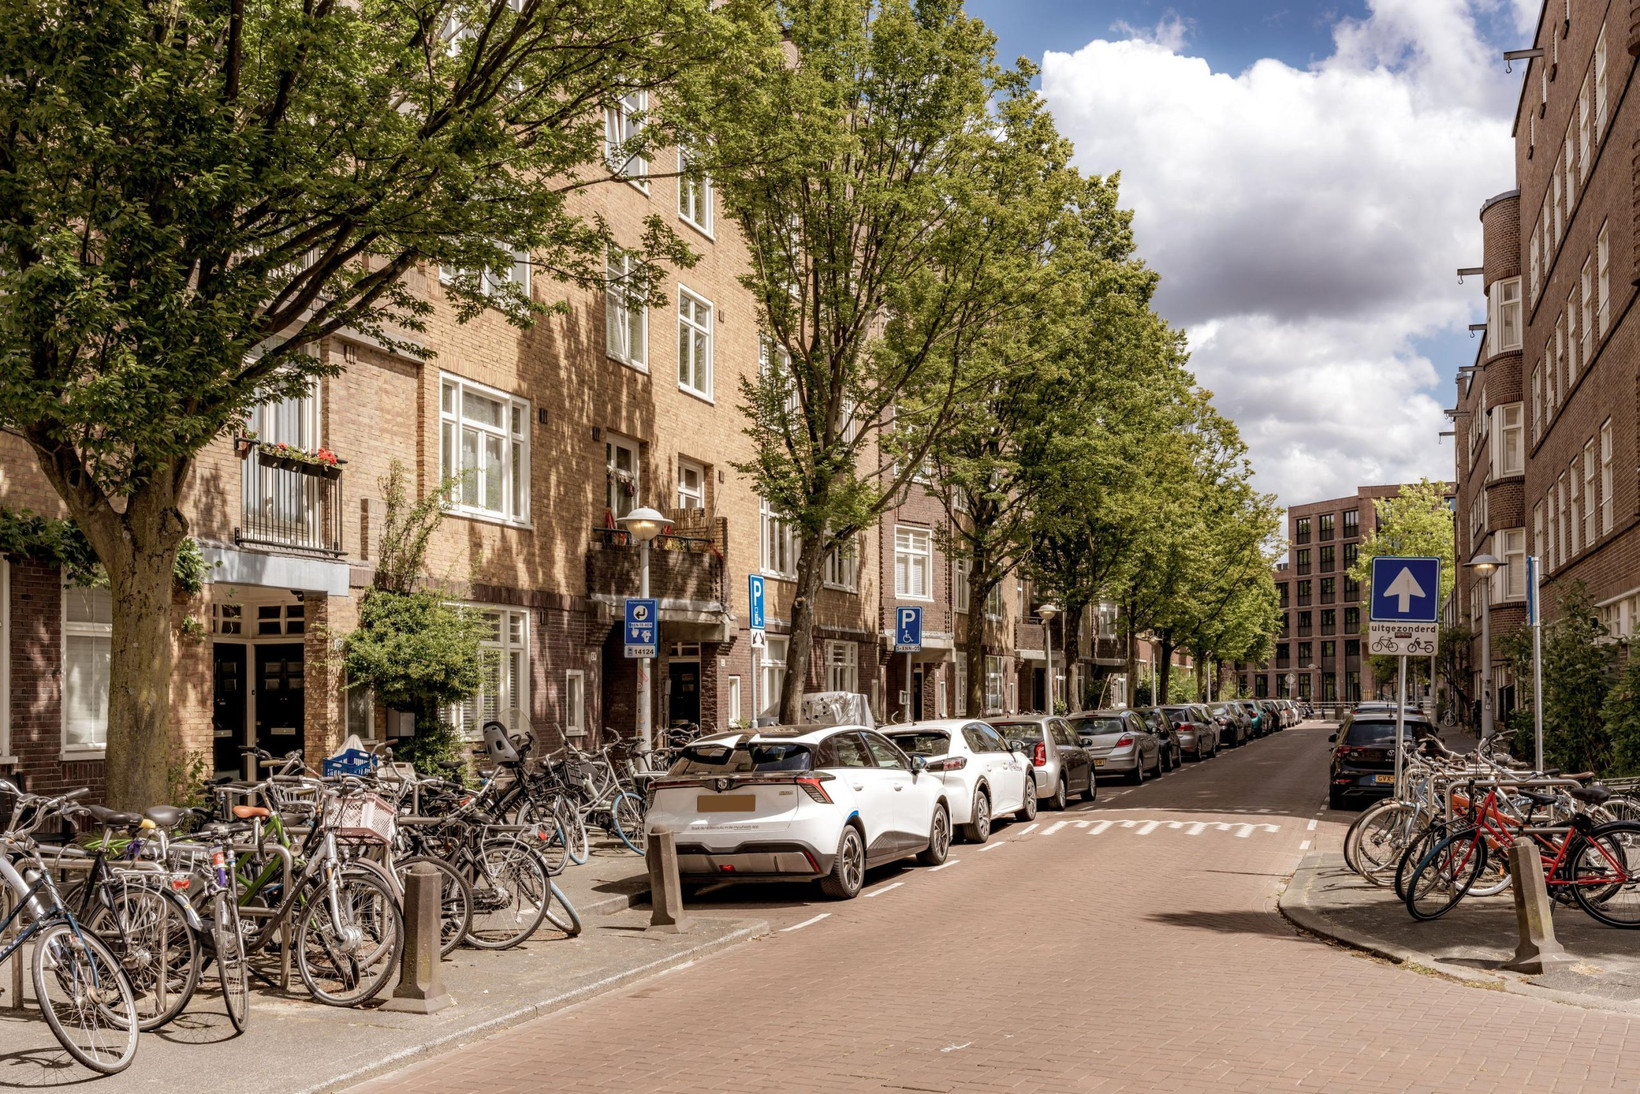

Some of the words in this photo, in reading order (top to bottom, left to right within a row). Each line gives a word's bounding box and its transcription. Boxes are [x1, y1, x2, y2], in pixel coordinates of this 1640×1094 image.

[753, 580, 762, 606] P
[902, 609, 916, 629] P
[1371, 624, 1436, 634] uitgezonderd
